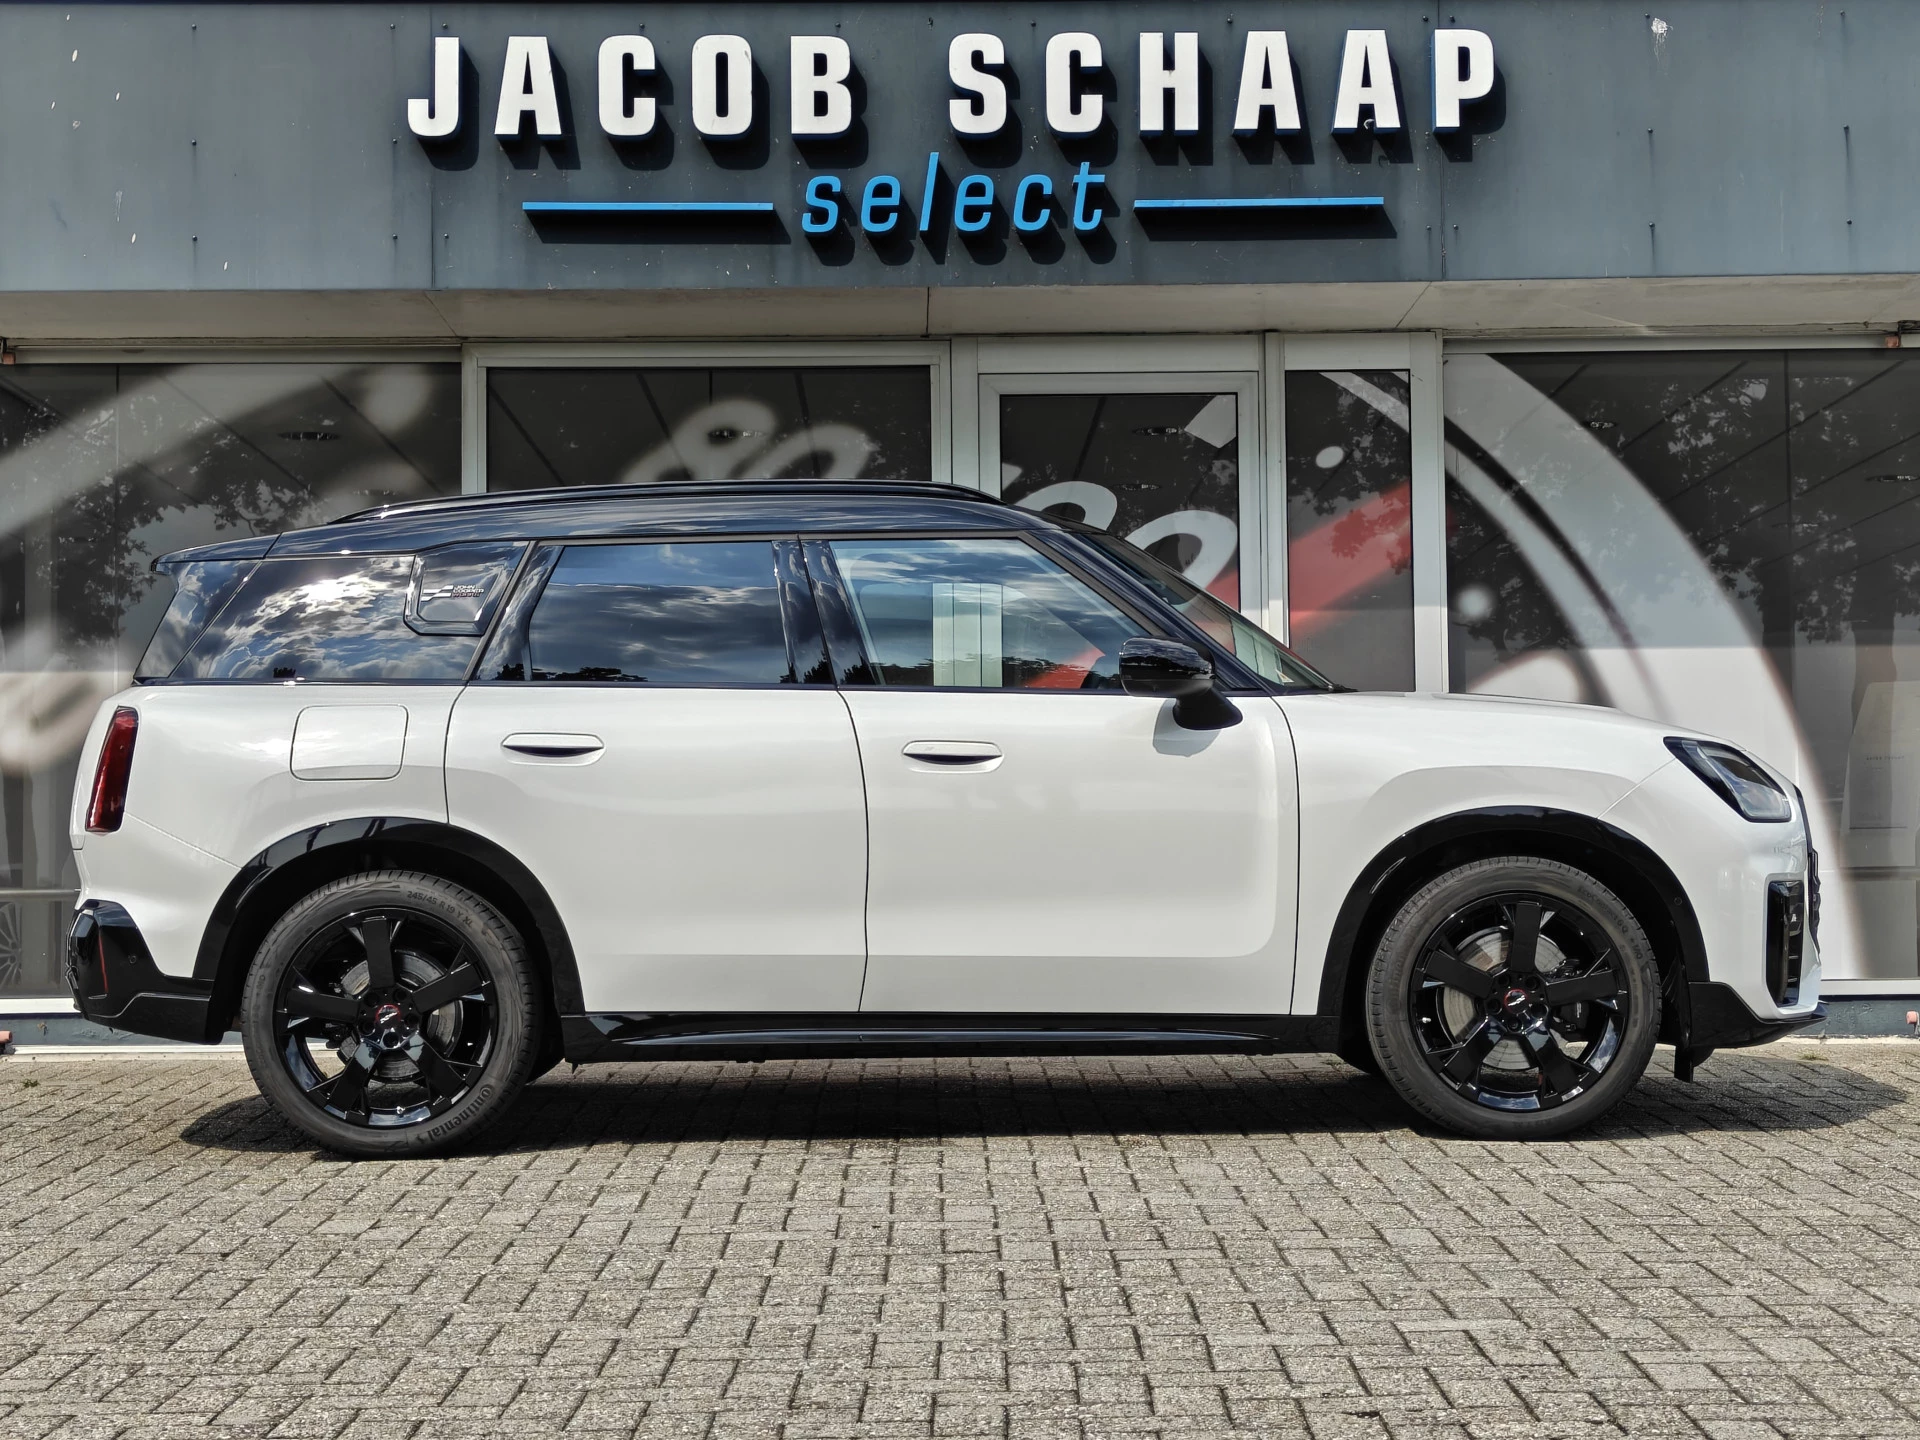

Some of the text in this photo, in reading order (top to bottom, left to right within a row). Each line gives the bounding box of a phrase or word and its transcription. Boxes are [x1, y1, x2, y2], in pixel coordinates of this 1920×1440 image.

[407, 29, 1495, 138] JACOB SCHAAP
[801, 151, 1106, 234] select
[407, 890, 473, 928] 245/45 R 19 Y XL
[427, 1084, 495, 1141] Continental
